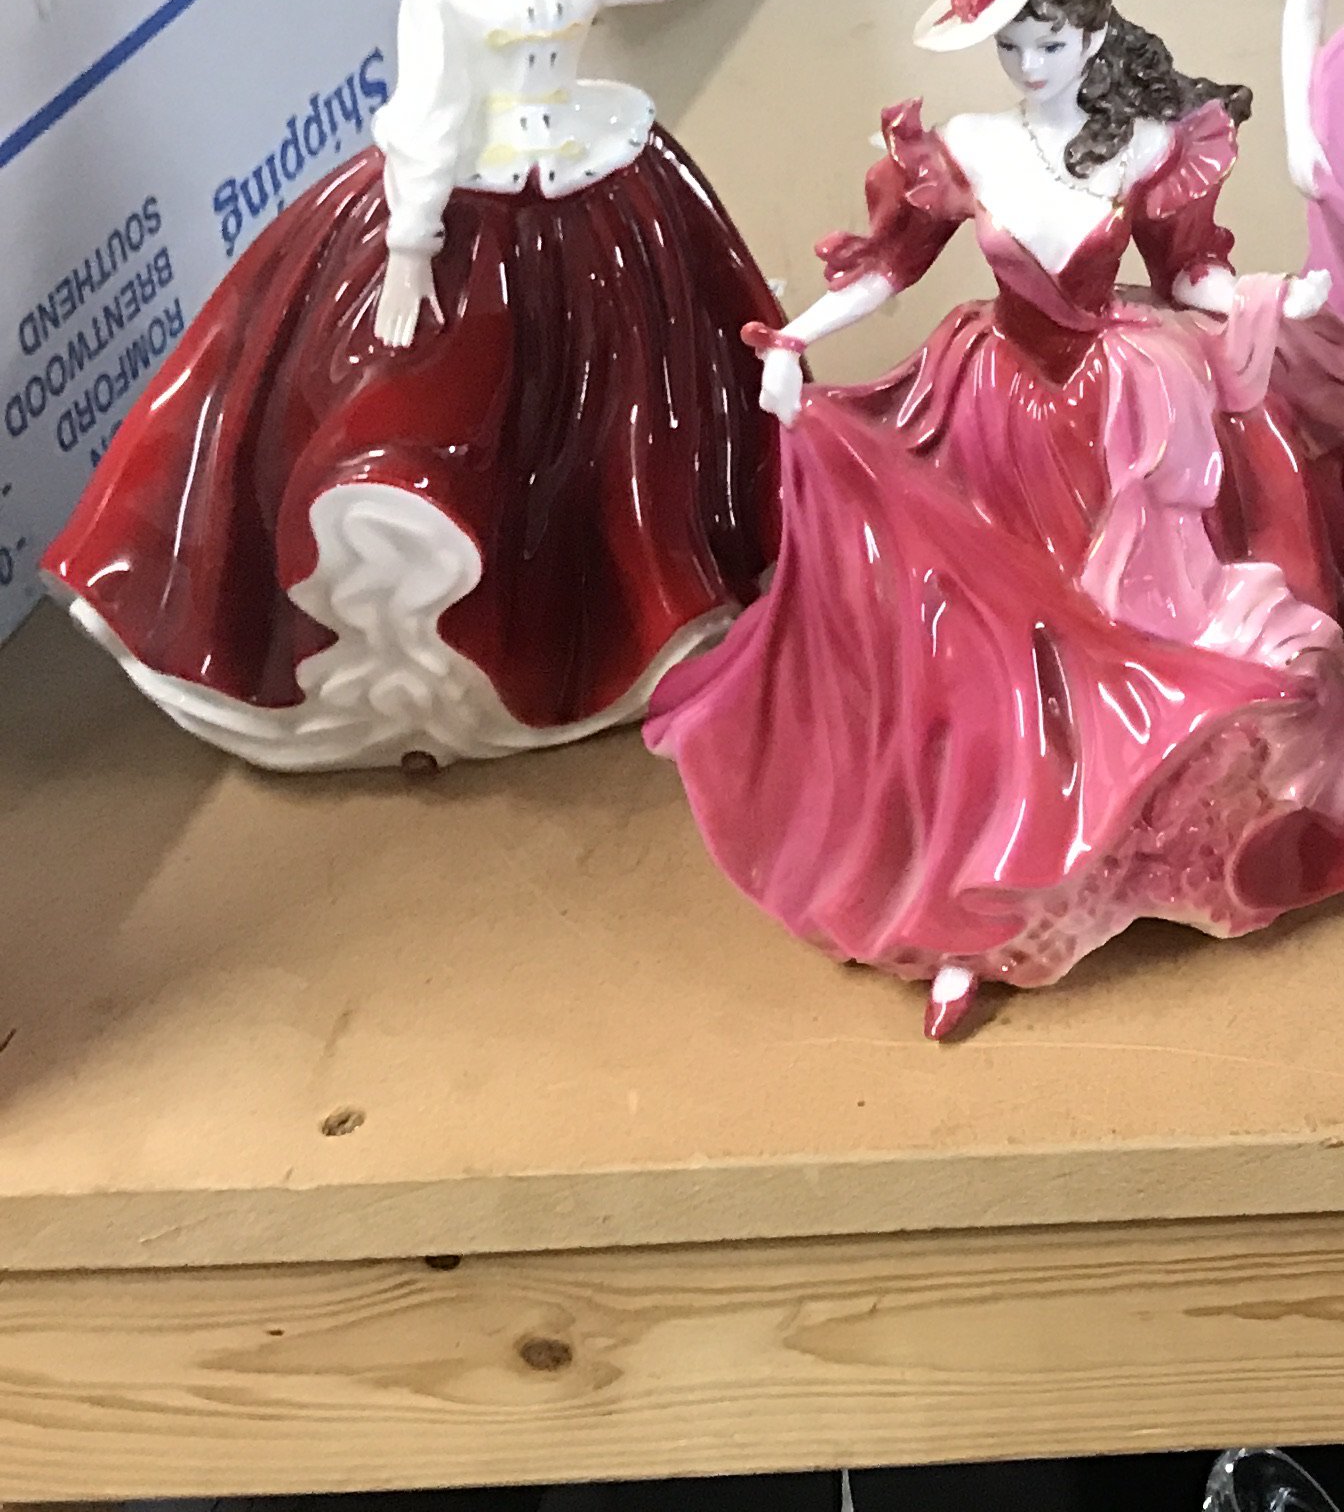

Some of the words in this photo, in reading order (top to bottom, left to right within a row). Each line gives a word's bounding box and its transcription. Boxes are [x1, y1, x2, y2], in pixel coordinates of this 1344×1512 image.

[212, 46, 388, 257] Shipping
[4, 246, 174, 437] BRENTWOOD
[18, 195, 162, 356] SOUTHEND
[56, 298, 186, 453] ROMFORD
